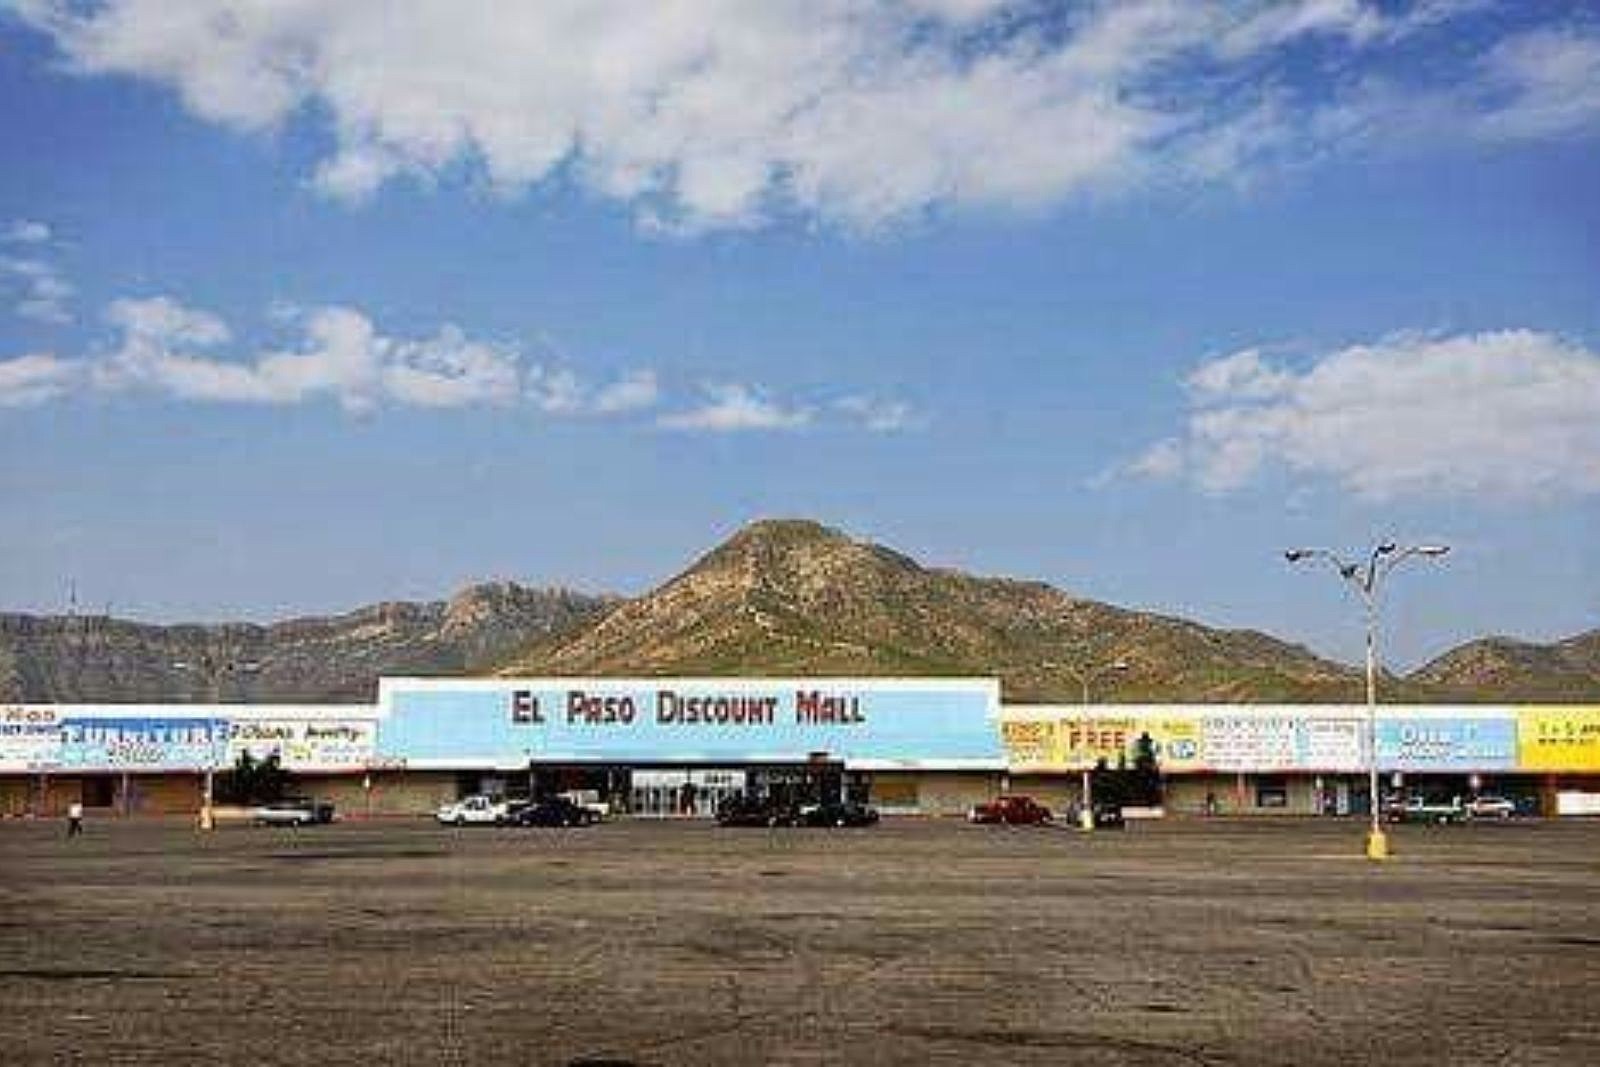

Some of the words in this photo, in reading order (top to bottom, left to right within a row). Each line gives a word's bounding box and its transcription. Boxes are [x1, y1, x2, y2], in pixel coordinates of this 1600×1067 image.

[512, 691, 545, 722] EL
[567, 691, 635, 723] PASO
[656, 691, 777, 724] DISCOUNT
[795, 690, 865, 724] MALL
[1069, 730, 1127, 750] FREE
